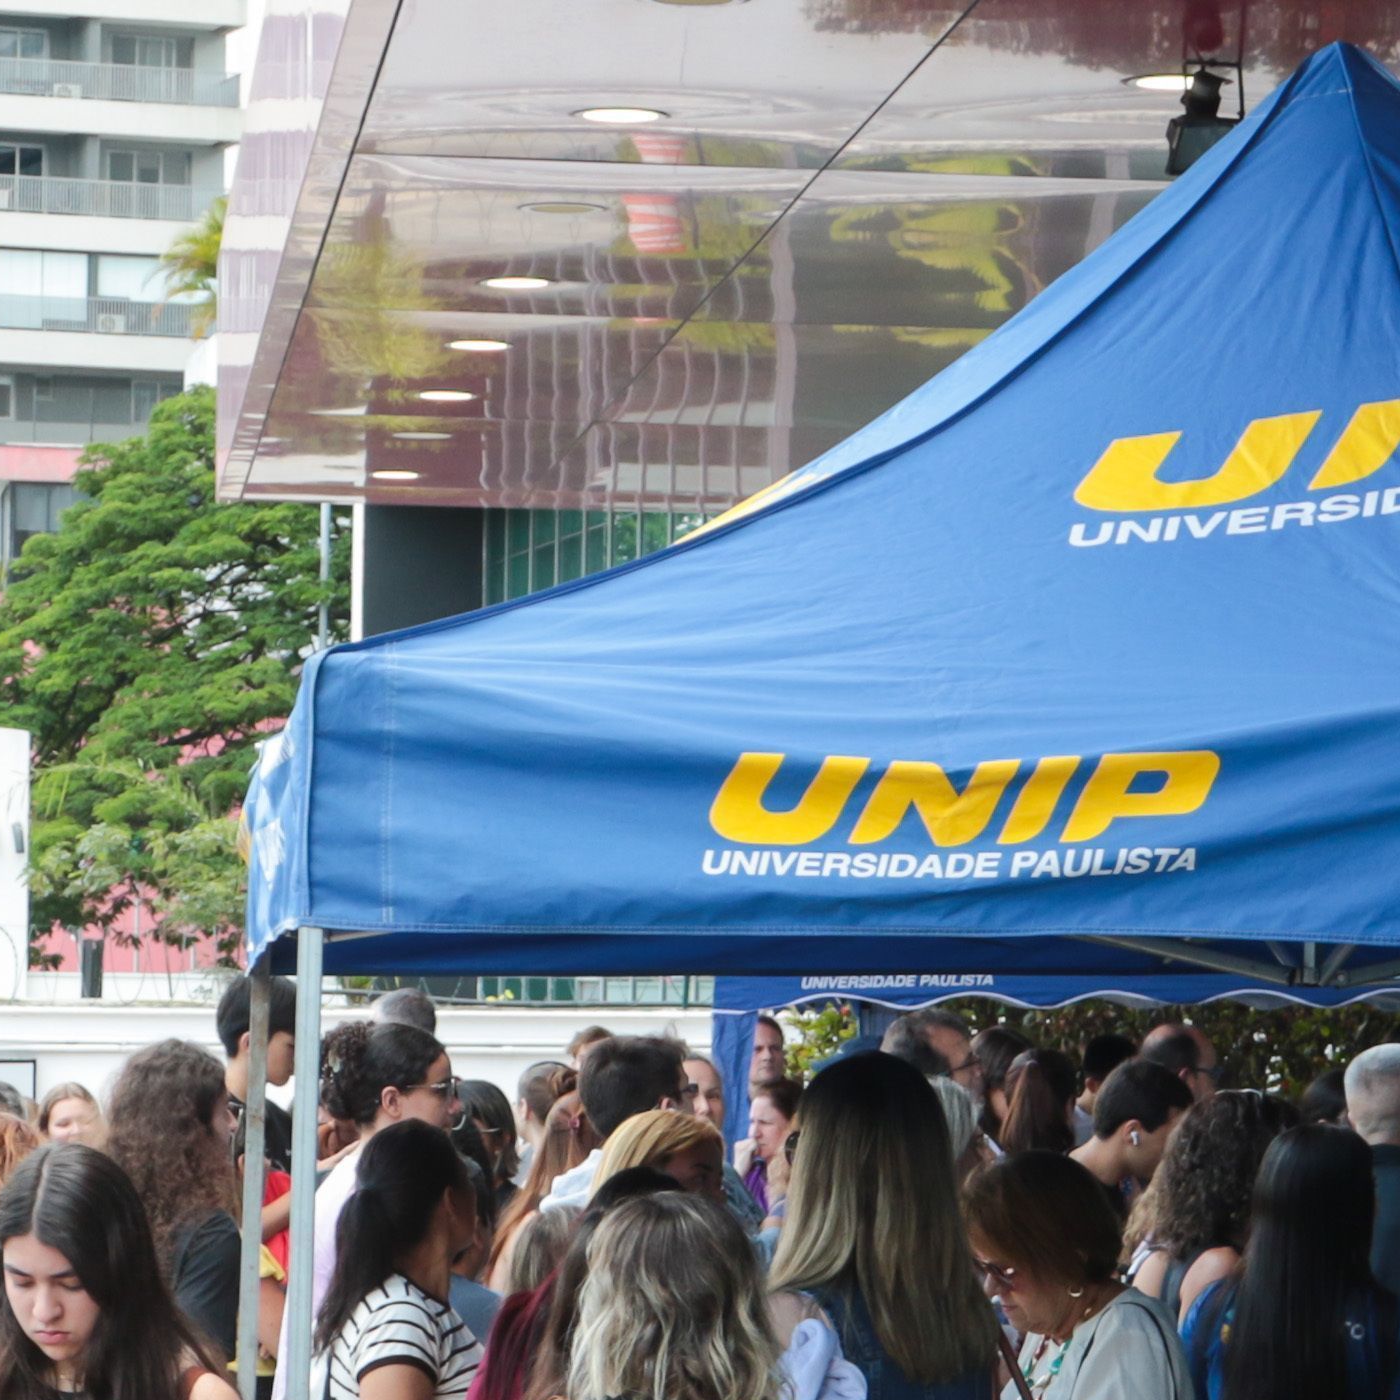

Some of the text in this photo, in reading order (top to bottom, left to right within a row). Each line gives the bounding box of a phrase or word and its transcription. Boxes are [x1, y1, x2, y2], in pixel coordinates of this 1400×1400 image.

[708, 750, 1221, 847] UNIP
[701, 846, 1197, 879] UNIVERSIDADE PAULISTA
[801, 974, 995, 990] UNIVERSIDADE PAULISTA
